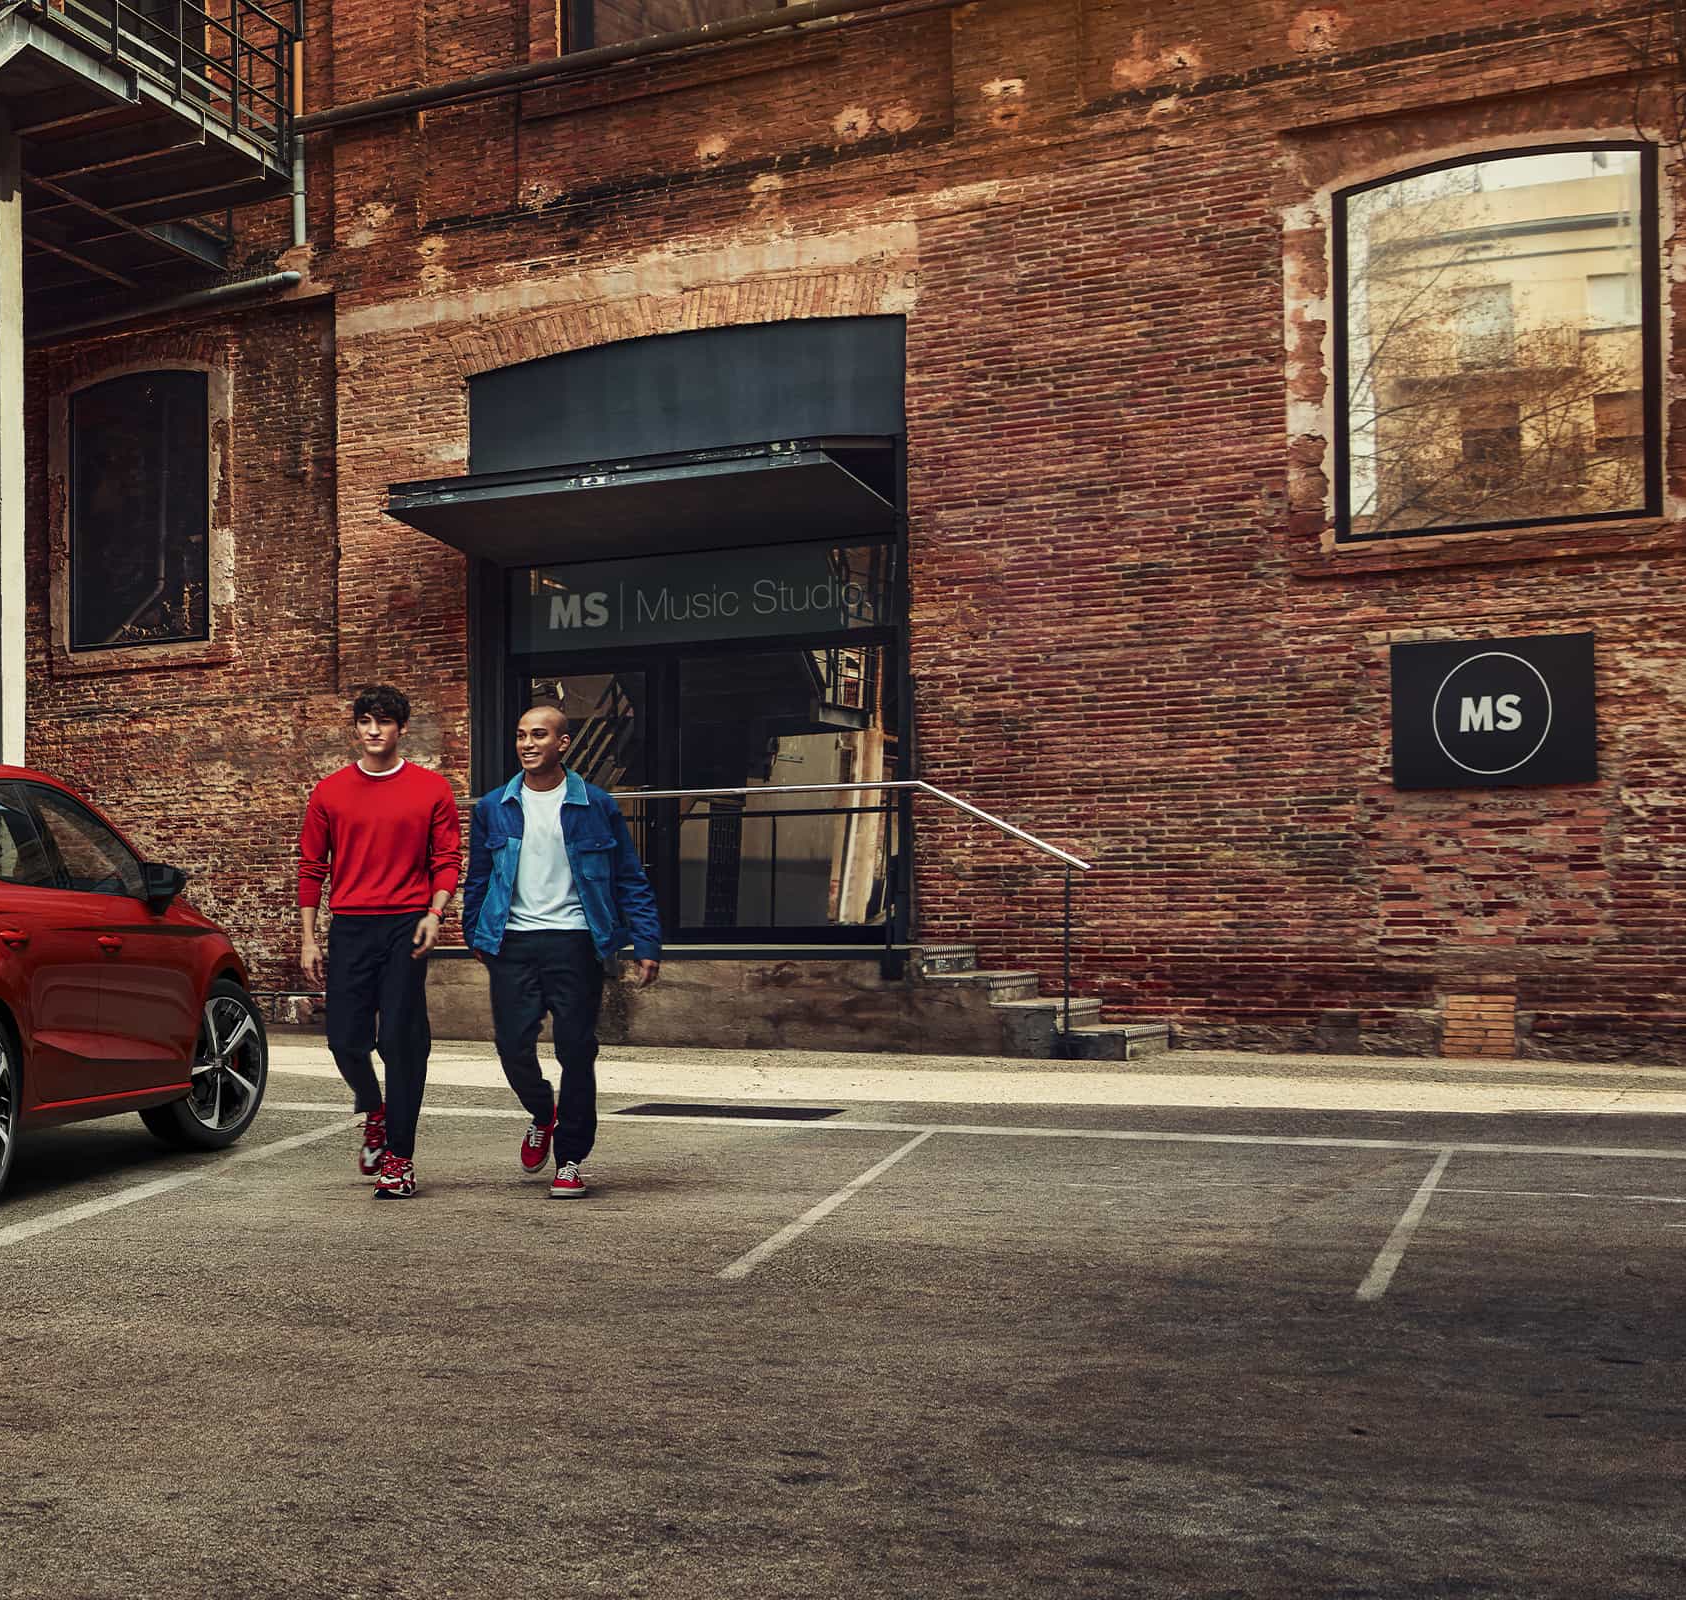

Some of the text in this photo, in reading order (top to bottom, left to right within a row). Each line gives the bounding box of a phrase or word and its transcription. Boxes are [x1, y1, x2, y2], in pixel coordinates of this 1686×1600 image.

[549, 575, 863, 629] MS Music Studio
[1459, 694, 1522, 732] MS
